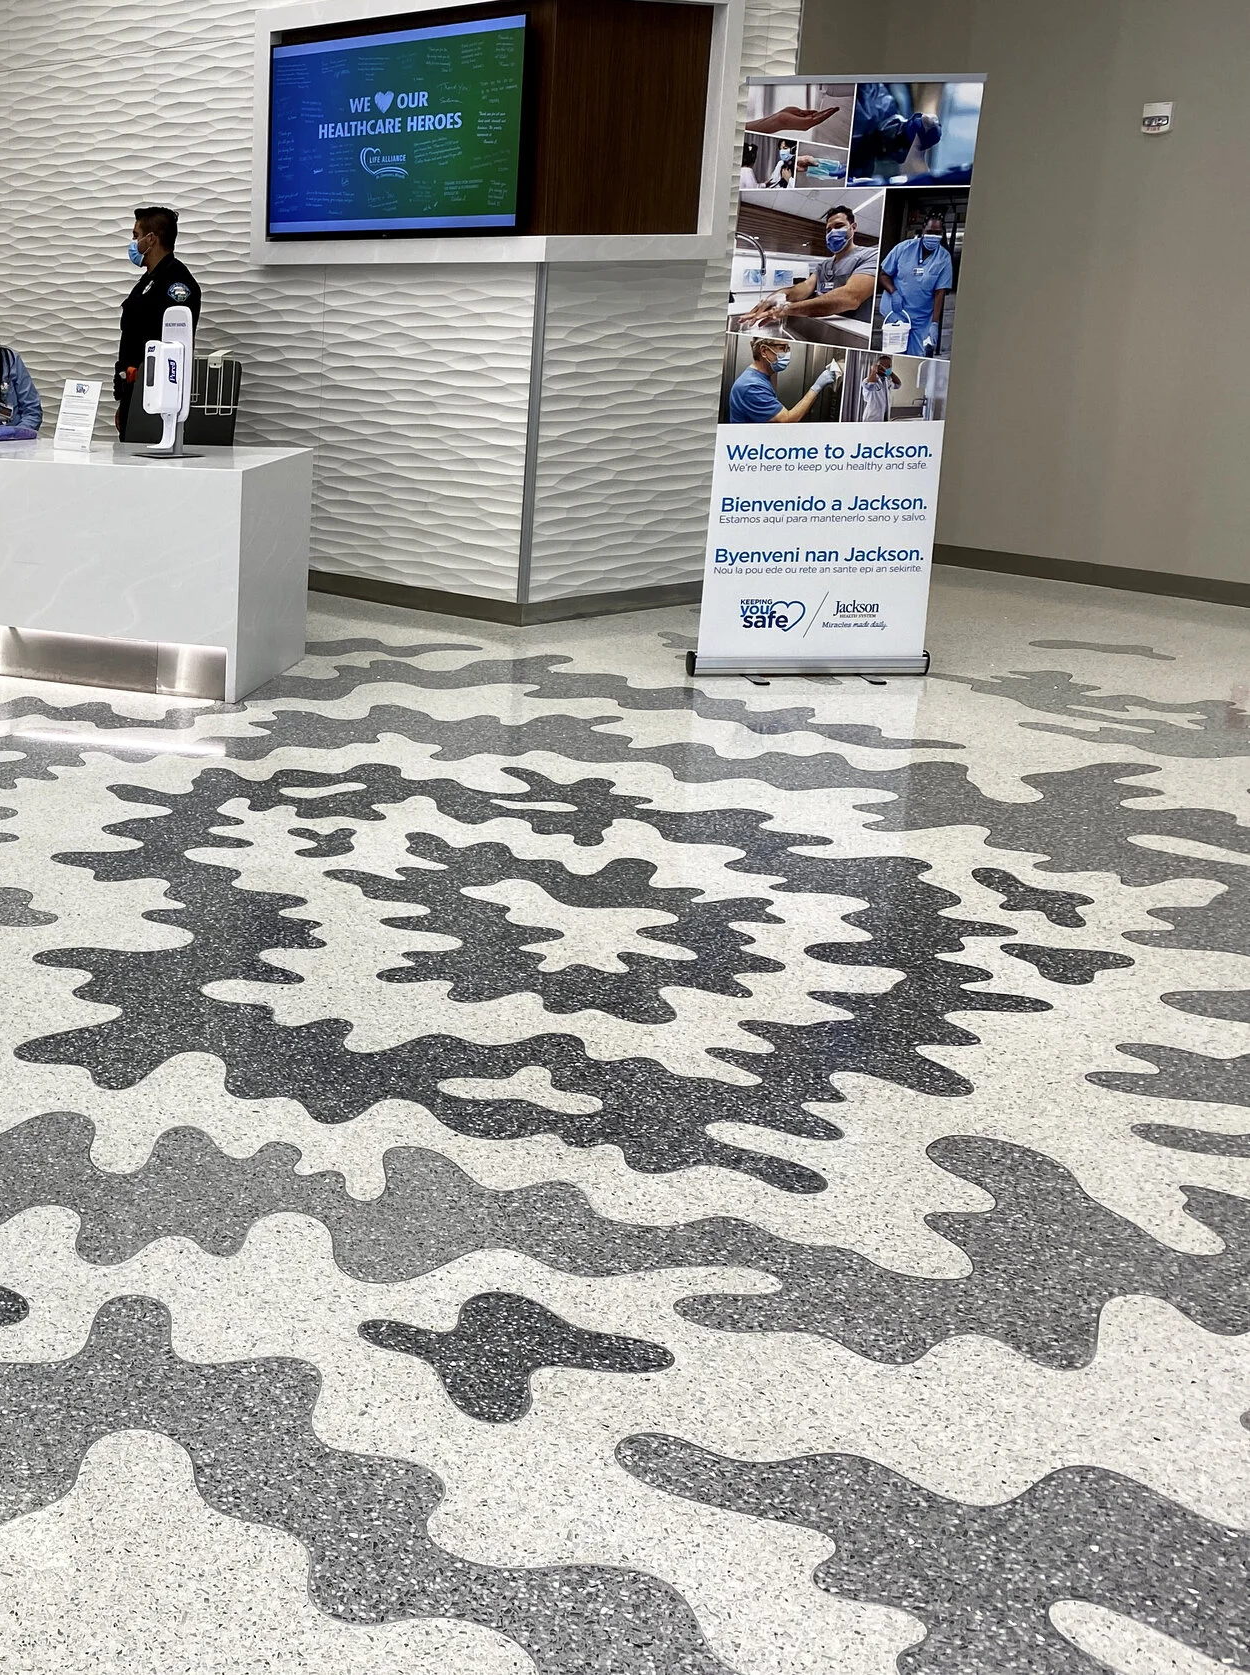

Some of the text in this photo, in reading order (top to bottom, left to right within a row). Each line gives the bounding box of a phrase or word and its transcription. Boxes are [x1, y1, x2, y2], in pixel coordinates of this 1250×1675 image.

[350, 91, 429, 113] WE OUR
[318, 117, 402, 139] HEALTHCARE
[407, 112, 463, 132] HEROES
[369, 154, 407, 164] LIFE ALLIANCE
[726, 442, 933, 460] Welcome to Jackson.
[728, 463, 758, 472] We're
[759, 463, 782, 472] here
[784, 463, 795, 472] to
[797, 462, 823, 472] keep
[824, 463, 844, 473] you
[846, 461, 883, 472] healthy
[885, 461, 905, 470] and
[721, 494, 928, 512] Bienvenido a Jackson.
[719, 515, 761, 524] Estamos
[786, 515, 808, 525] para
[810, 514, 866, 523] mantenerlo
[867, 514, 891, 522] sano
[893, 514, 900, 523] y
[715, 546, 924, 566] Byenveni nan Jackson.
[713, 566, 733, 574] Nou
[735, 566, 743, 574] la
[745, 567, 763, 576] pou
[765, 566, 783, 574] ede
[799, 566, 818, 574] rete
[833, 565, 858, 574] sante
[859, 565, 874, 574] epi
[740, 605, 770, 618] you
[832, 599, 879, 617] Jackson
[742, 610, 789, 629] safe
[852, 620, 870, 628] made
